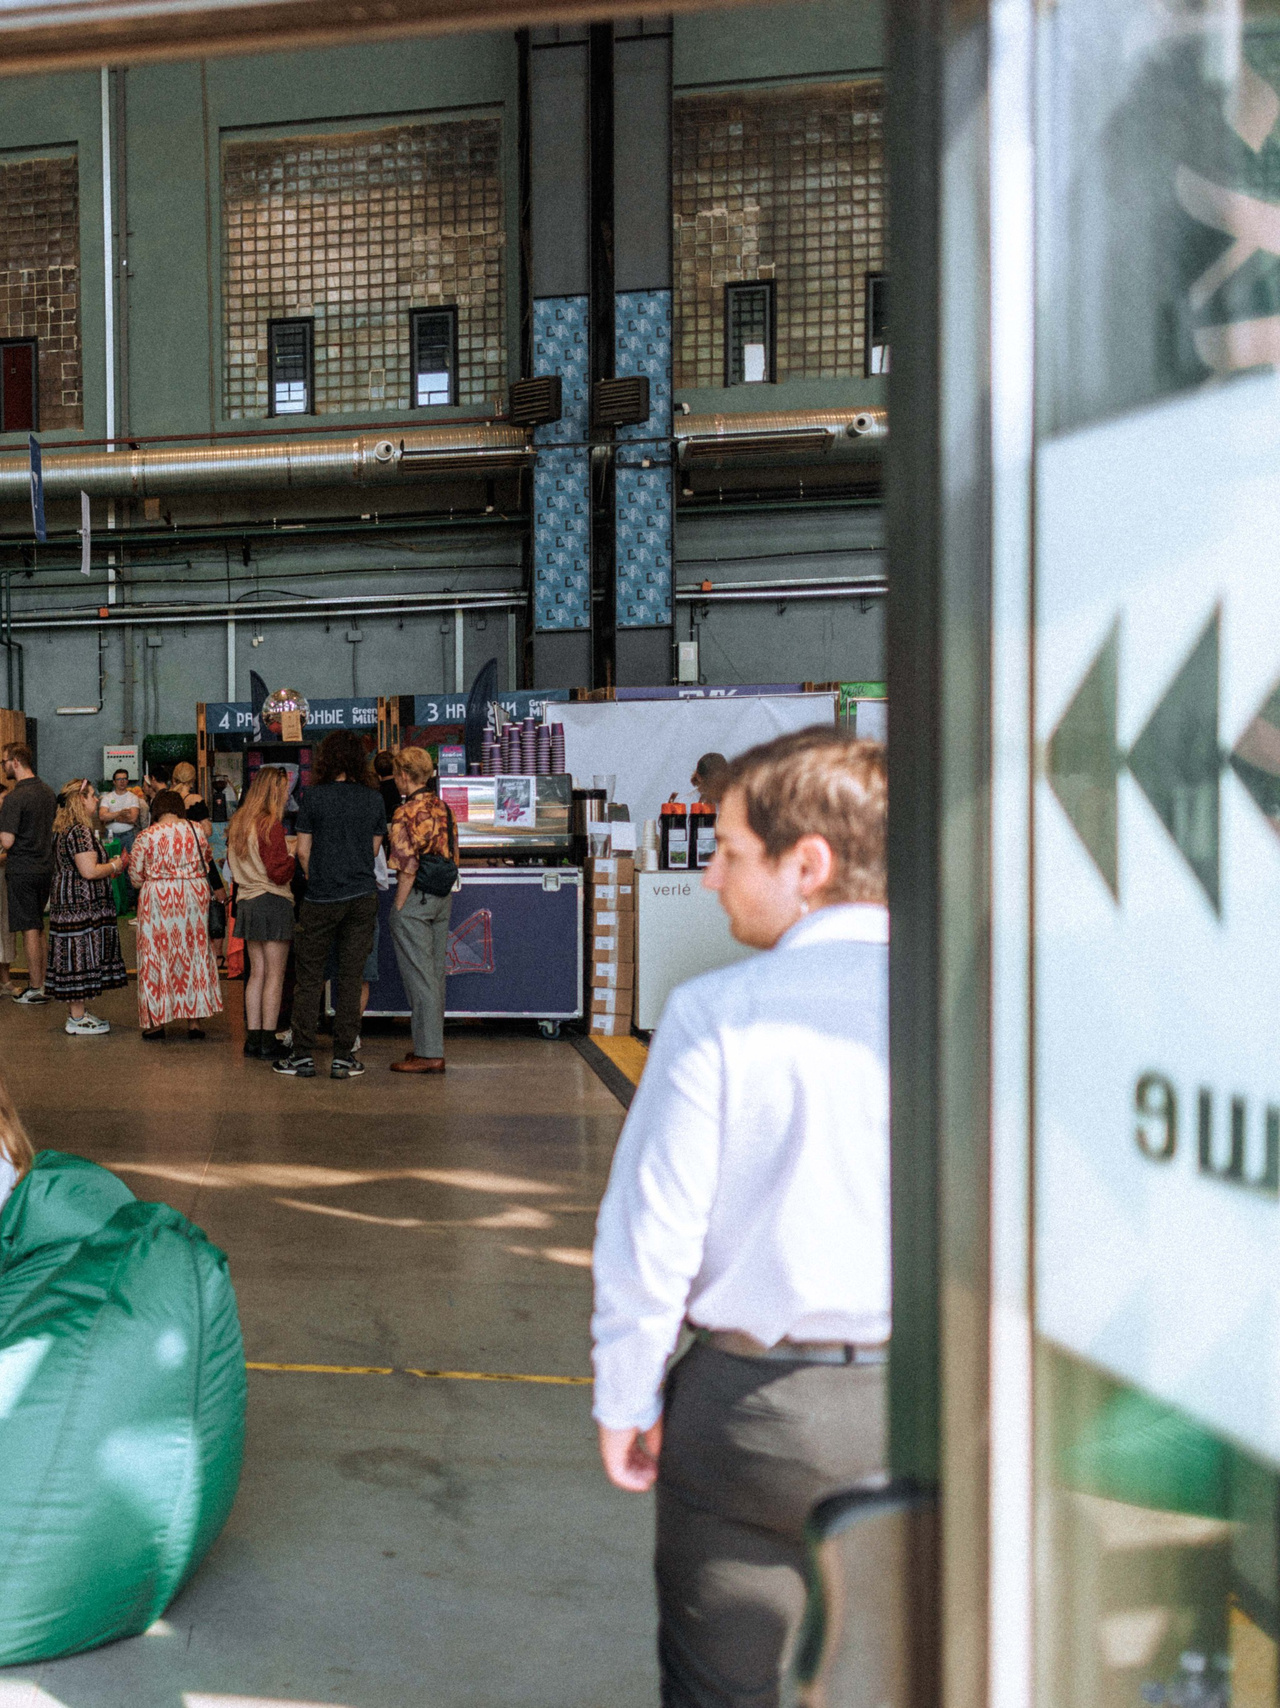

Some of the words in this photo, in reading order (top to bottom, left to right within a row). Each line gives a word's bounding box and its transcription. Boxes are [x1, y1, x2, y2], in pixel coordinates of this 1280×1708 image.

[352, 707, 378, 715] Green
[427, 703, 439, 722] 3
[219, 711, 230, 730] 4
[352, 715, 378, 725] Milk
[653, 883, 691, 896] verlé
